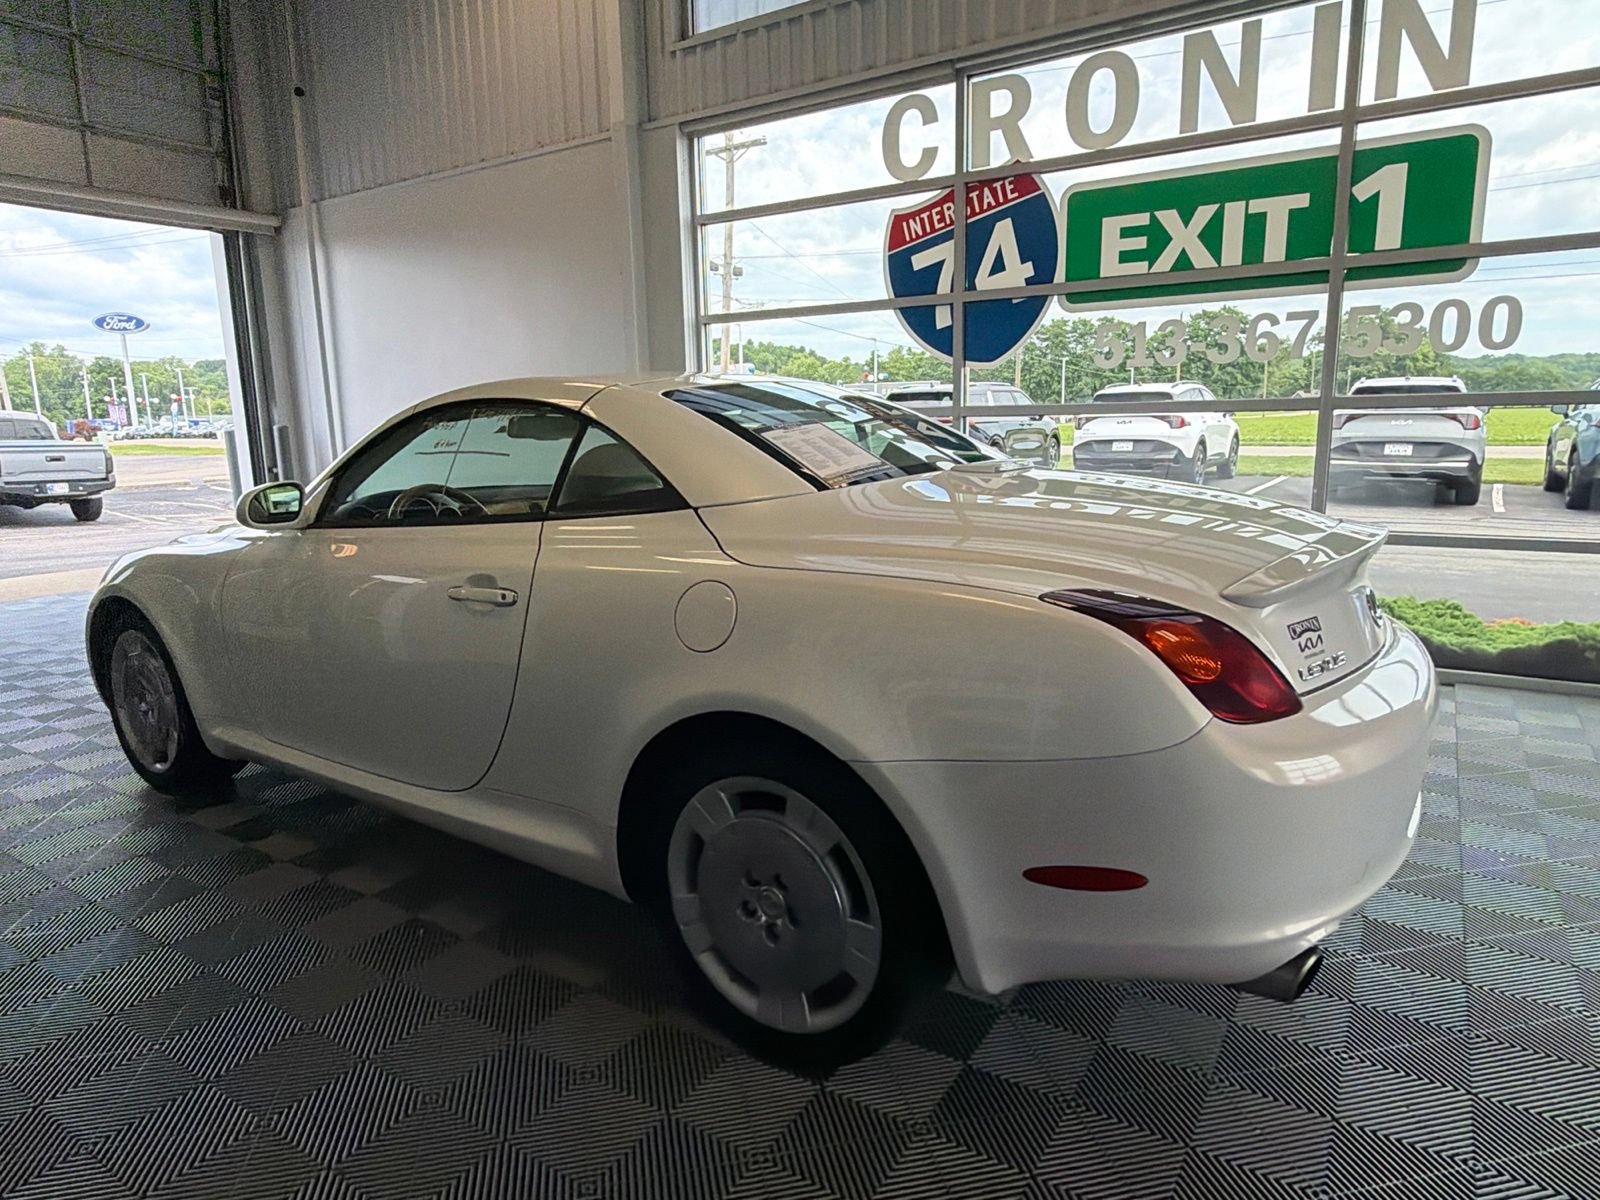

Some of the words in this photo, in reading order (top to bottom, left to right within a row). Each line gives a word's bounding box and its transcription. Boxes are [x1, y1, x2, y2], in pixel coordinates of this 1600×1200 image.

[881, 0, 1476, 182] CRONIN
[902, 176, 1019, 241] INTERTATE
[1100, 193, 1310, 278] EXIT
[1351, 162, 1409, 252] 1
[103, 316, 137, 330] Ford
[911, 217, 1035, 330] 74
